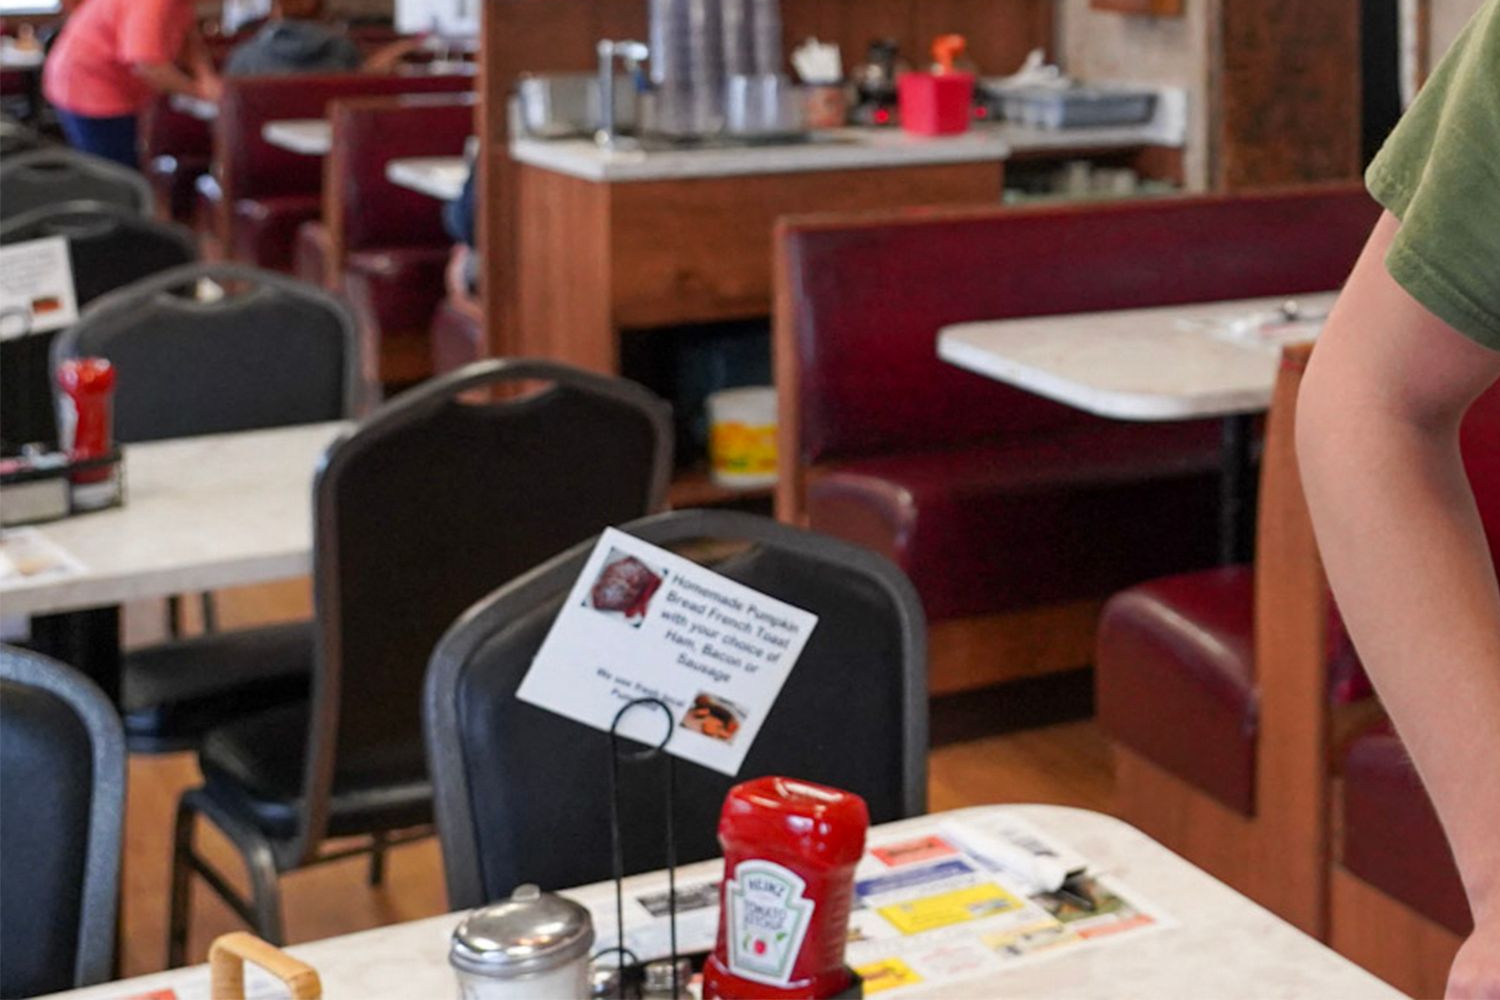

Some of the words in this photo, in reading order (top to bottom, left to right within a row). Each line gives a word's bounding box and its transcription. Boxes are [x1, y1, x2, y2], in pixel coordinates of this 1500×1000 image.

[666, 589, 706, 615] Bread
[708, 607, 752, 634] French
[672, 574, 743, 611] Homemade
[747, 603, 800, 633] Pumpkin
[661, 611, 688, 627] with
[688, 622, 720, 639] your
[721, 635, 764, 658] choice
[766, 651, 782, 664] of
[677, 652, 731, 683] Sausage
[702, 642, 742, 667] Bacon
[745, 662, 760, 673] or
[748, 880, 787, 898] HEINZ
